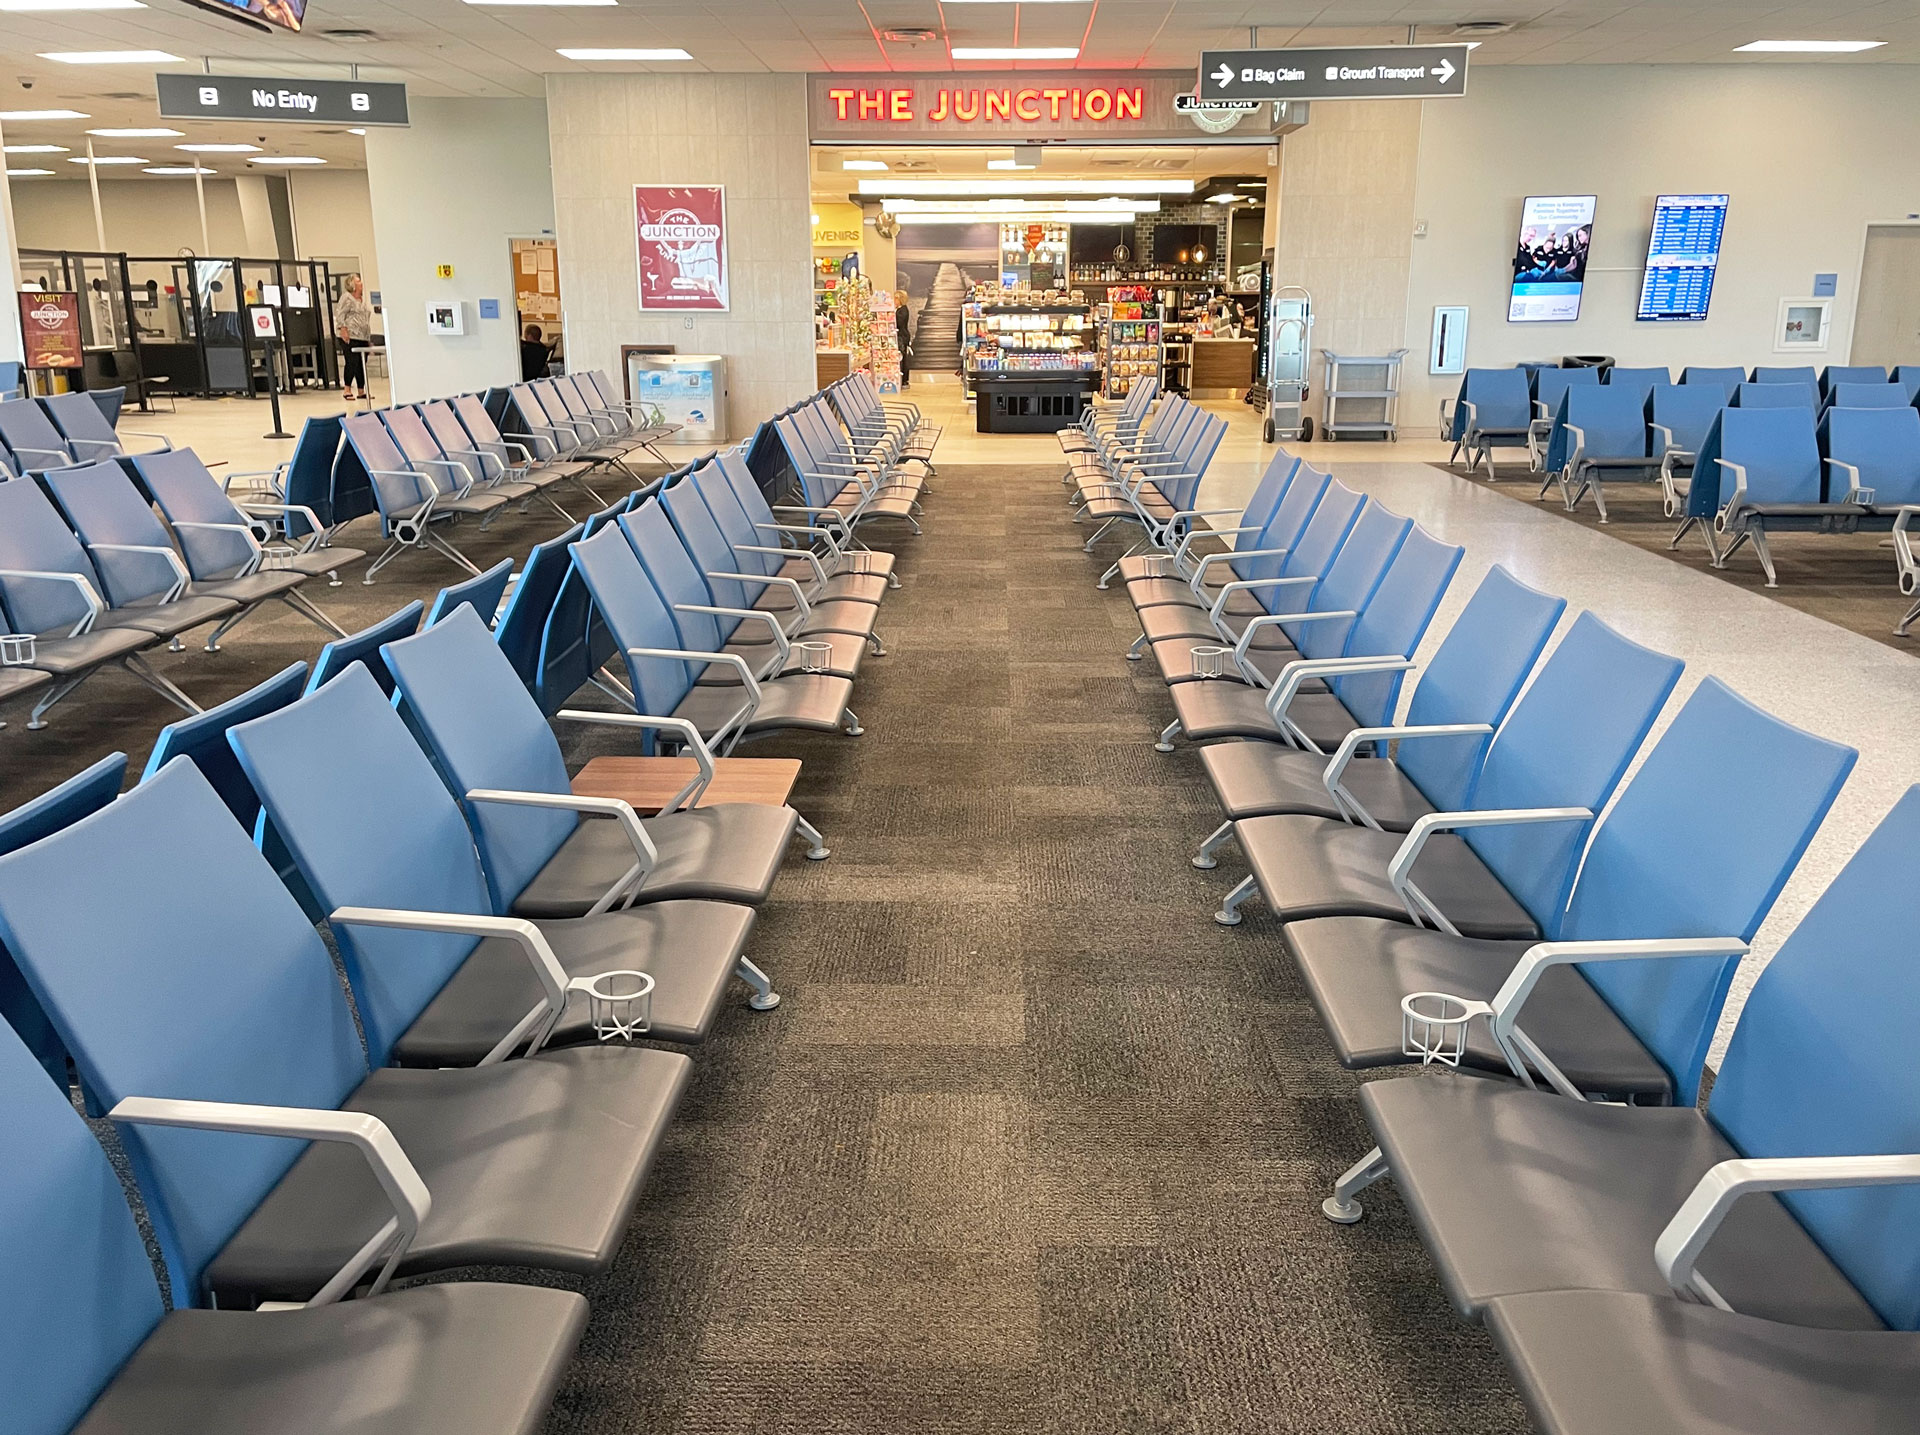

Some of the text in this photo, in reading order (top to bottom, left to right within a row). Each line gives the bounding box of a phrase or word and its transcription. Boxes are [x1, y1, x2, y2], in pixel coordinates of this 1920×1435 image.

[1254, 68, 1305, 84] Bag Claim
[1339, 66, 1425, 81] Ground Transport
[252, 89, 317, 112] No Entry
[829, 87, 1143, 121] THE JUNCTION
[670, 215, 690, 224] THE
[645, 227, 716, 237] JUNCTION
[33, 294, 63, 303] VISIT
